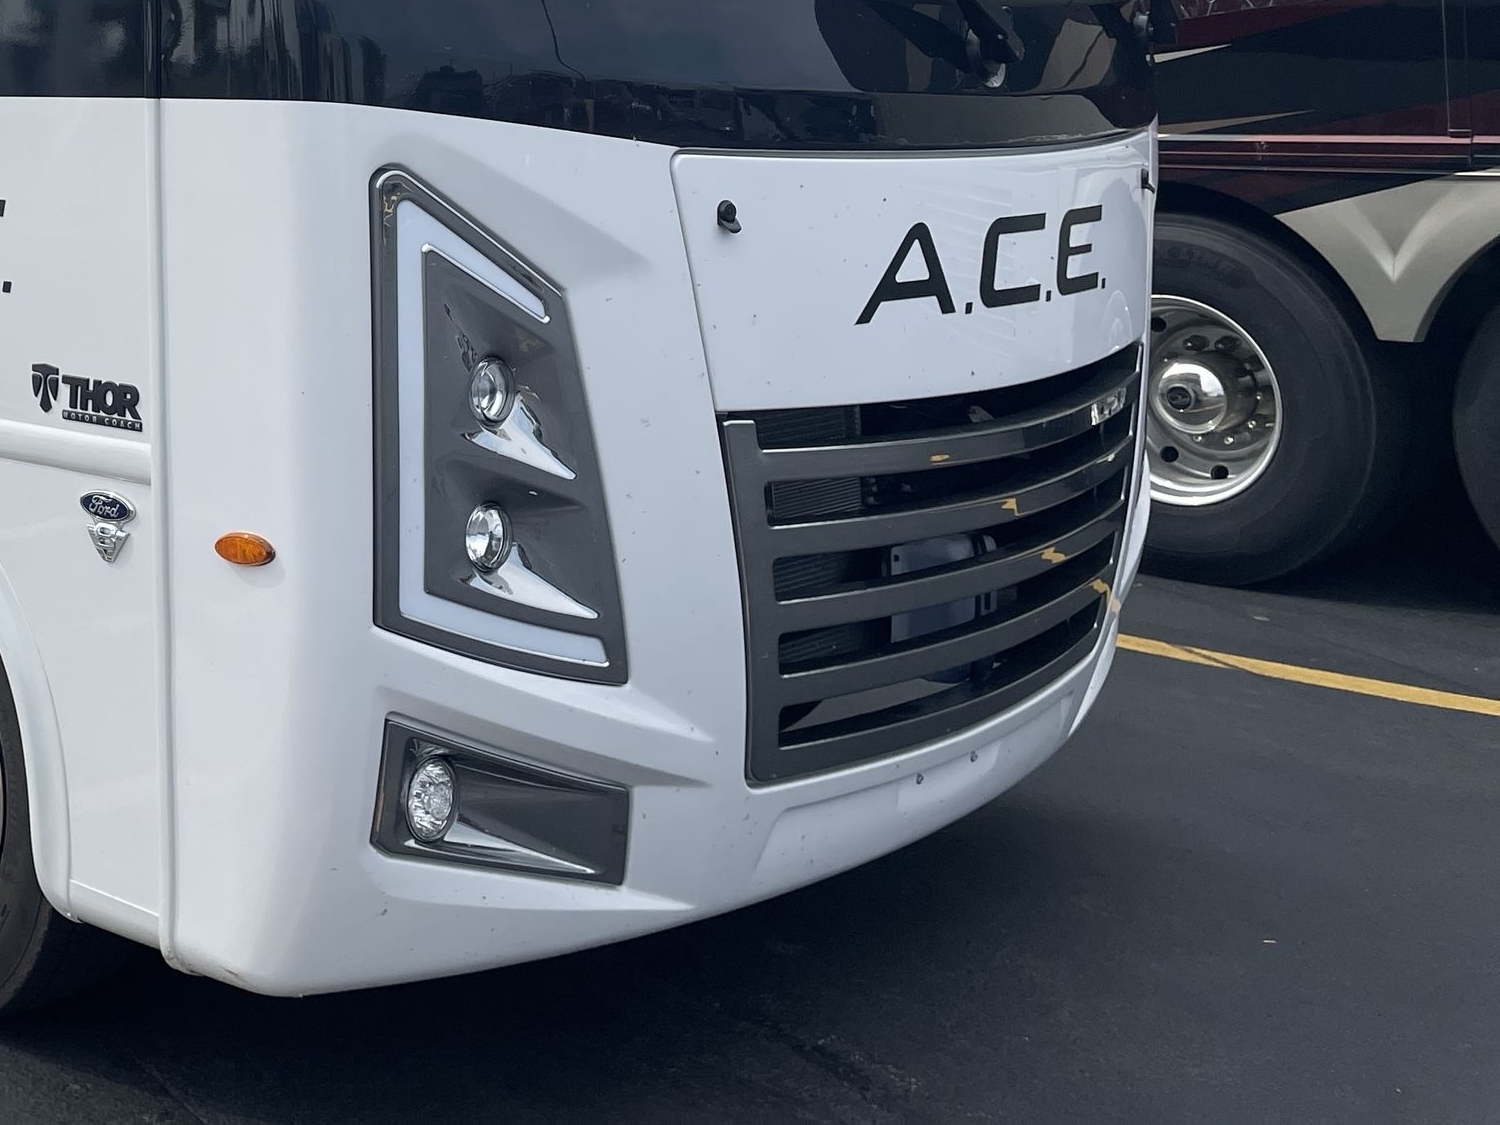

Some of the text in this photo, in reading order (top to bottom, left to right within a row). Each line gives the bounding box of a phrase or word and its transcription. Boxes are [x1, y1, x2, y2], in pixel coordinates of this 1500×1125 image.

[853, 204, 1107, 326] A.C.E.
[62, 374, 142, 421] THOR
[62, 410, 141, 430] MOTOR COACH
[88, 495, 120, 518] Ford
